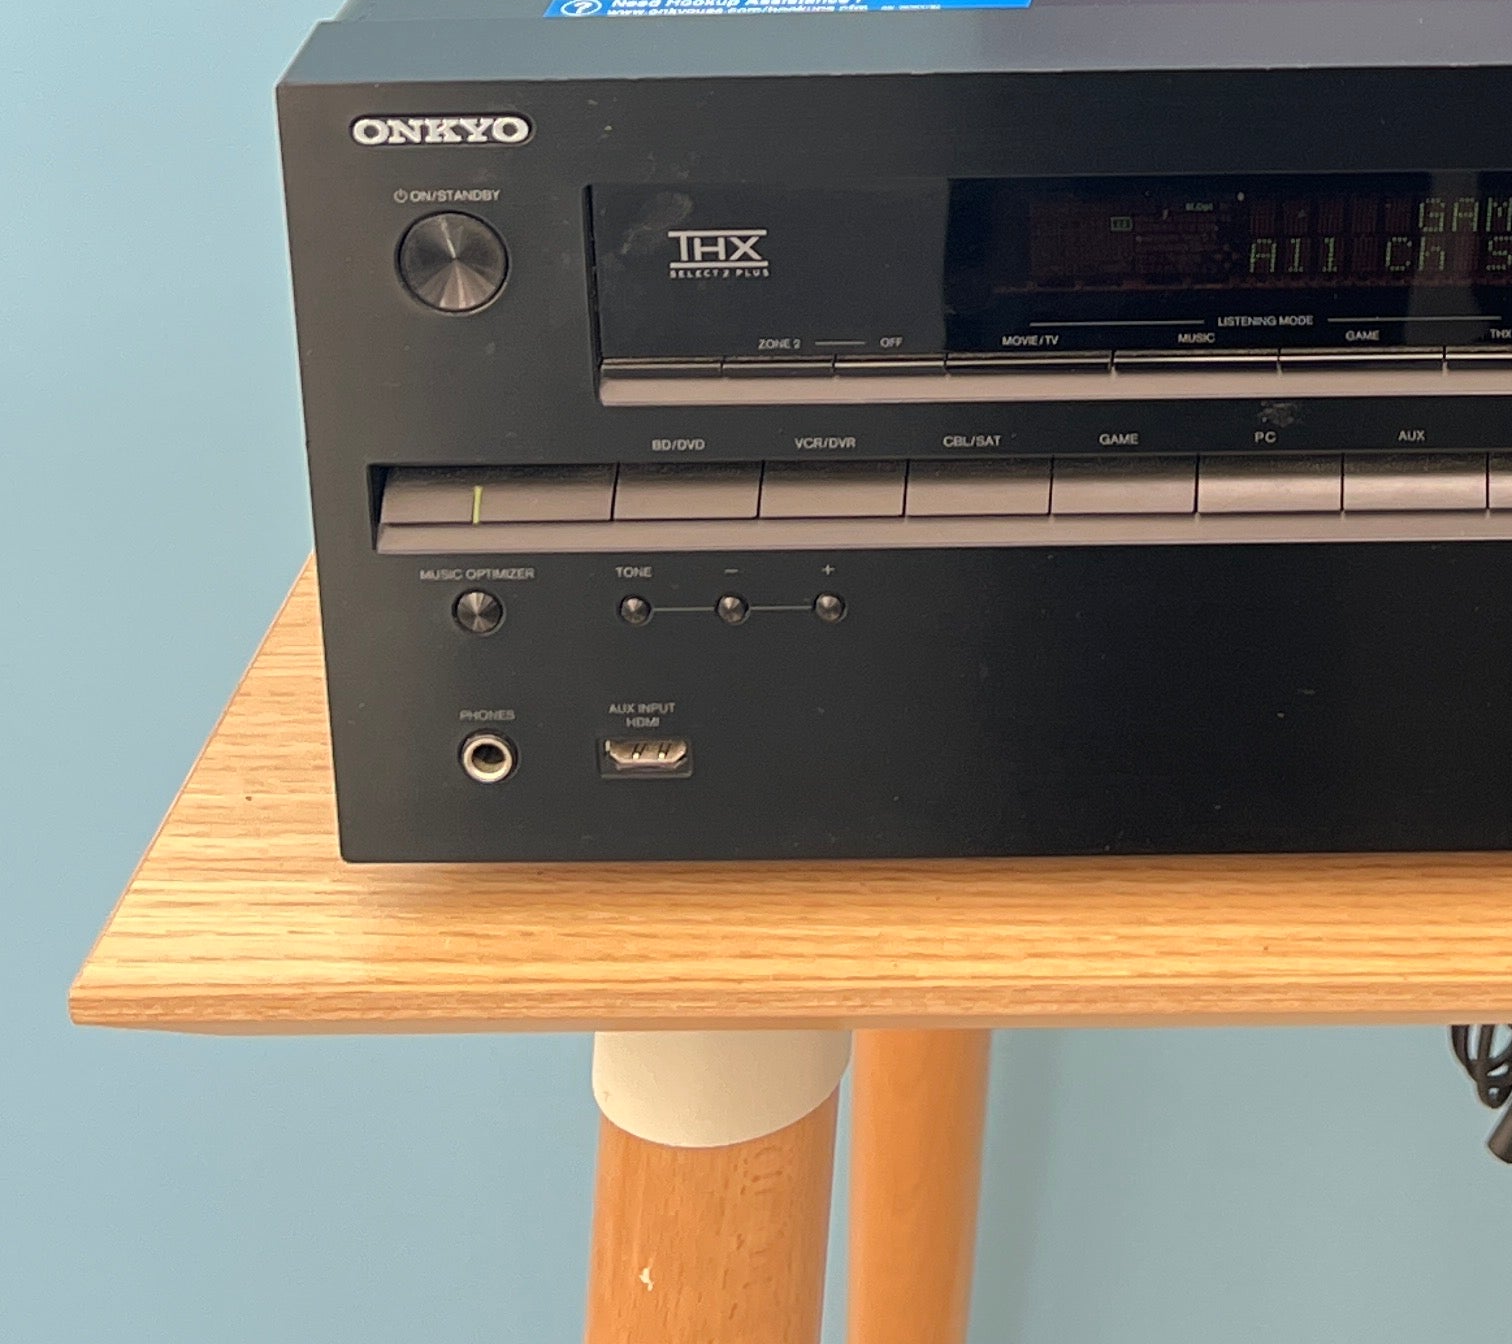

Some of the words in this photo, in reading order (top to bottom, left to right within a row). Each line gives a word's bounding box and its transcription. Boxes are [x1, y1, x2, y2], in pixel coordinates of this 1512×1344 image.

[352, 116, 529, 145] ONKYO
[410, 189, 500, 202] ON/STANDBY
[667, 229, 769, 269] THX
[1384, 236, 1446, 272] Ch
[735, 268, 770, 278] PLUS
[1217, 315, 1277, 327] LISTENING
[1278, 314, 1314, 326] MODE
[1177, 332, 1216, 344] MUSIC
[1345, 329, 1380, 341] GAME
[1489, 328, 1512, 339] THX
[757, 338, 791, 350] ZONE
[879, 337, 903, 349] OFF
[794, 436, 856, 449] VCR/DVR
[942, 435, 1001, 448] CBL/SAT
[1098, 432, 1139, 445] GAME
[1254, 431, 1277, 444] PC
[1398, 430, 1425, 442] AUX
[651, 438, 706, 451] BD/DVD
[419, 568, 463, 581] MUSIC
[465, 567, 535, 580] OPTIMIZER
[615, 566, 652, 578] TONE
[608, 702, 635, 714] AUX
[637, 701, 676, 715] INPUT
[459, 709, 515, 721] PHONES
[625, 716, 660, 728] HDMI
